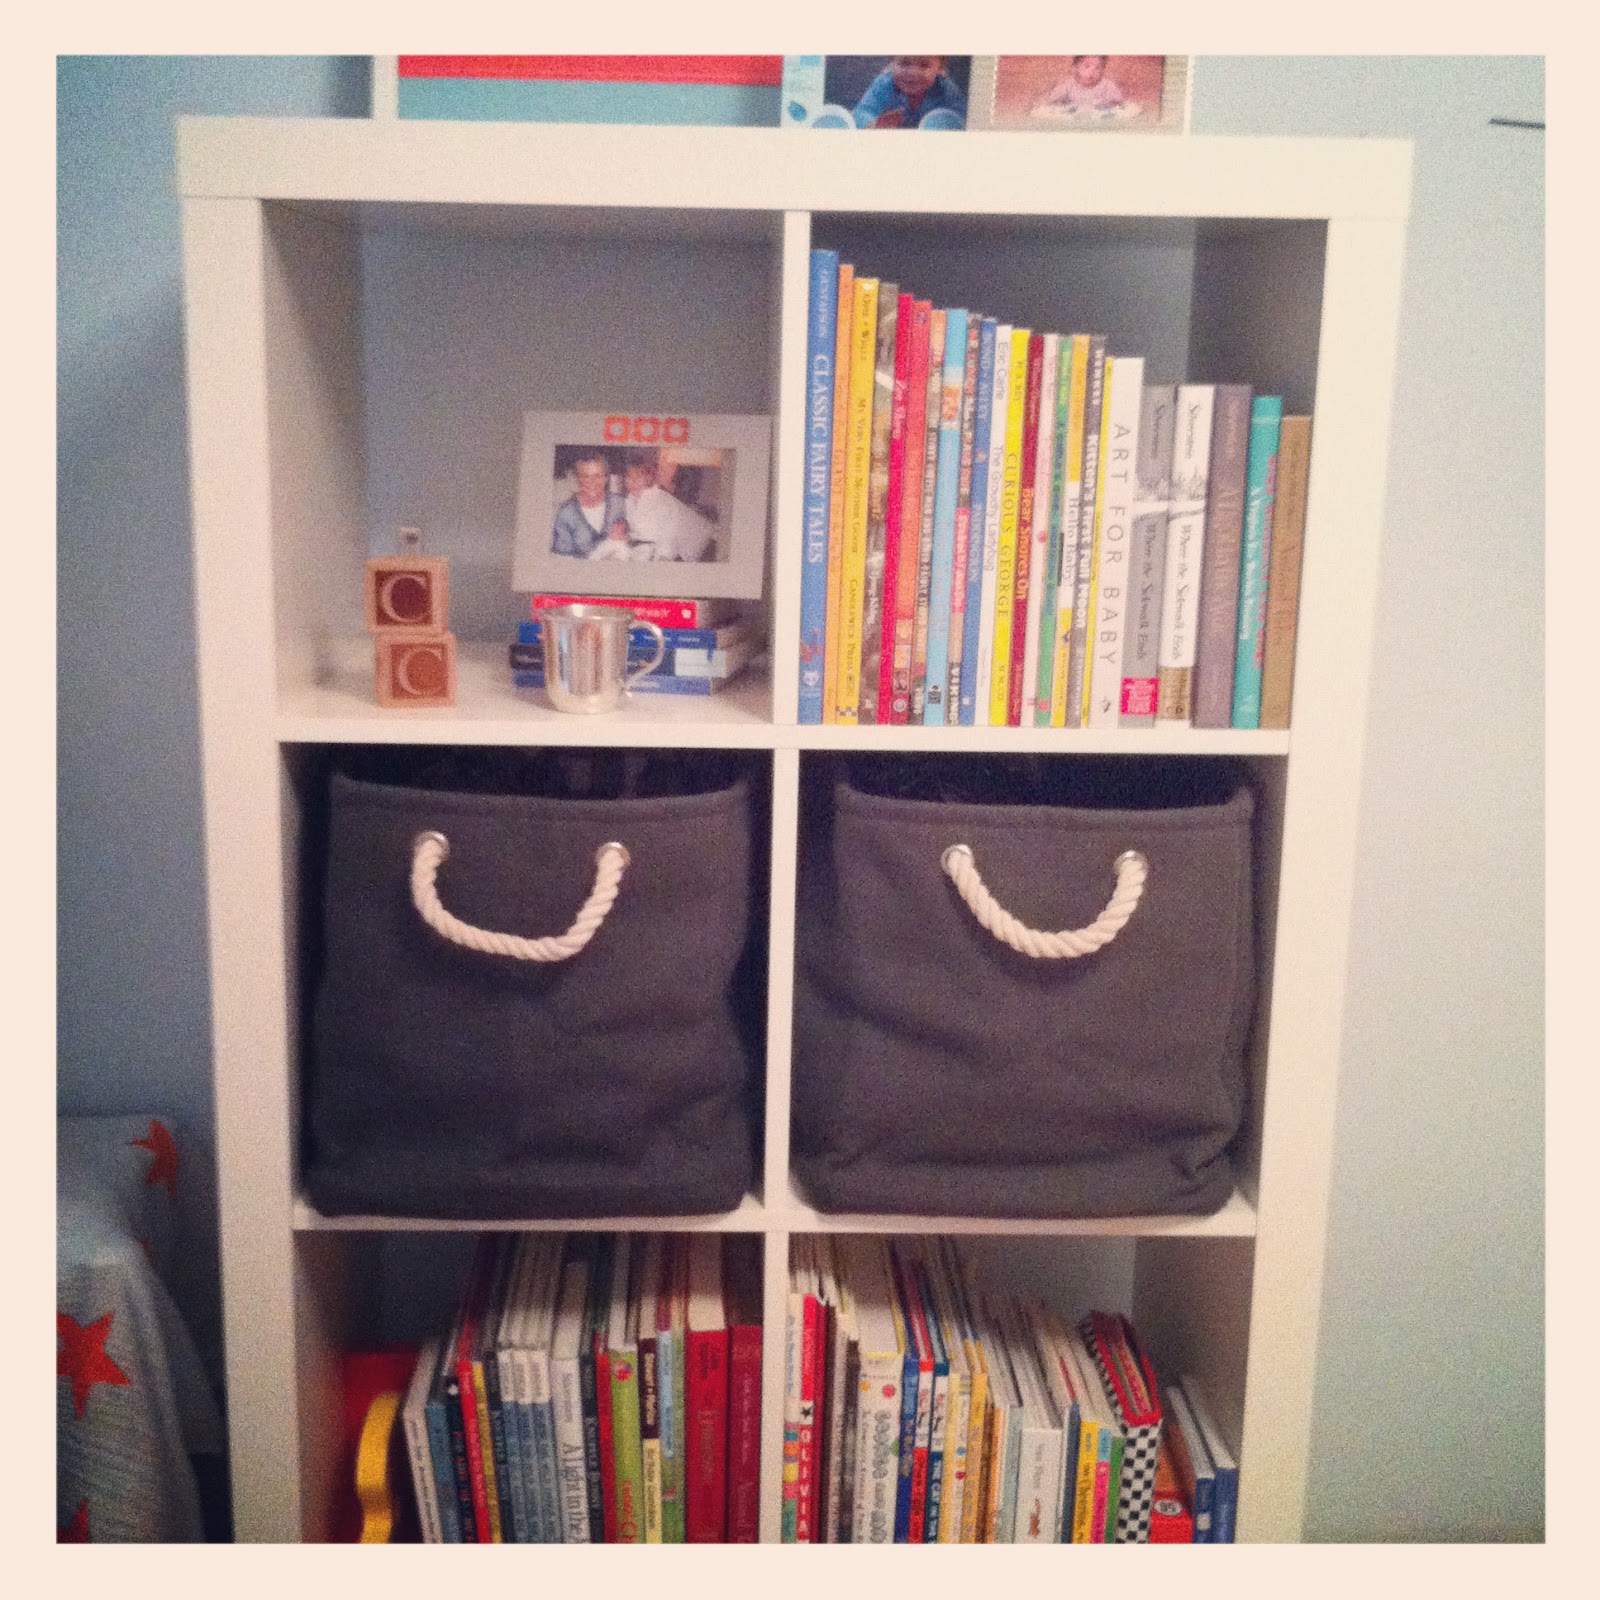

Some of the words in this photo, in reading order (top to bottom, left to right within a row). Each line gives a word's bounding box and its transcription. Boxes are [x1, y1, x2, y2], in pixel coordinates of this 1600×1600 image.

[997, 342, 1009, 363] Eric
[812, 354, 831, 438] CLASSIC
[994, 368, 1006, 400] Carle
[810, 443, 828, 497] FAIRY
[992, 444, 1004, 467] The
[1083, 434, 1098, 502] Kitten's
[1111, 424, 1131, 483] ART
[988, 470, 1002, 519] Grouchy
[1003, 453, 1017, 534] CURIOUS
[1020, 488, 1032, 522] Bear
[1066, 498, 1080, 539] Hello
[808, 504, 826, 564] TALES
[984, 522, 999, 572] Ladybug
[1081, 506, 1094, 544] First
[1104, 506, 1126, 564] FOR
[997, 545, 1011, 619] GEORGE
[1015, 578, 1028, 600] On
[1078, 550, 1092, 578] Full
[1075, 584, 1090, 628] Moon
[1099, 587, 1120, 664] BABY
[949, 667, 960, 720] VIKING
[799, 1428, 812, 1534] OLIVIA
